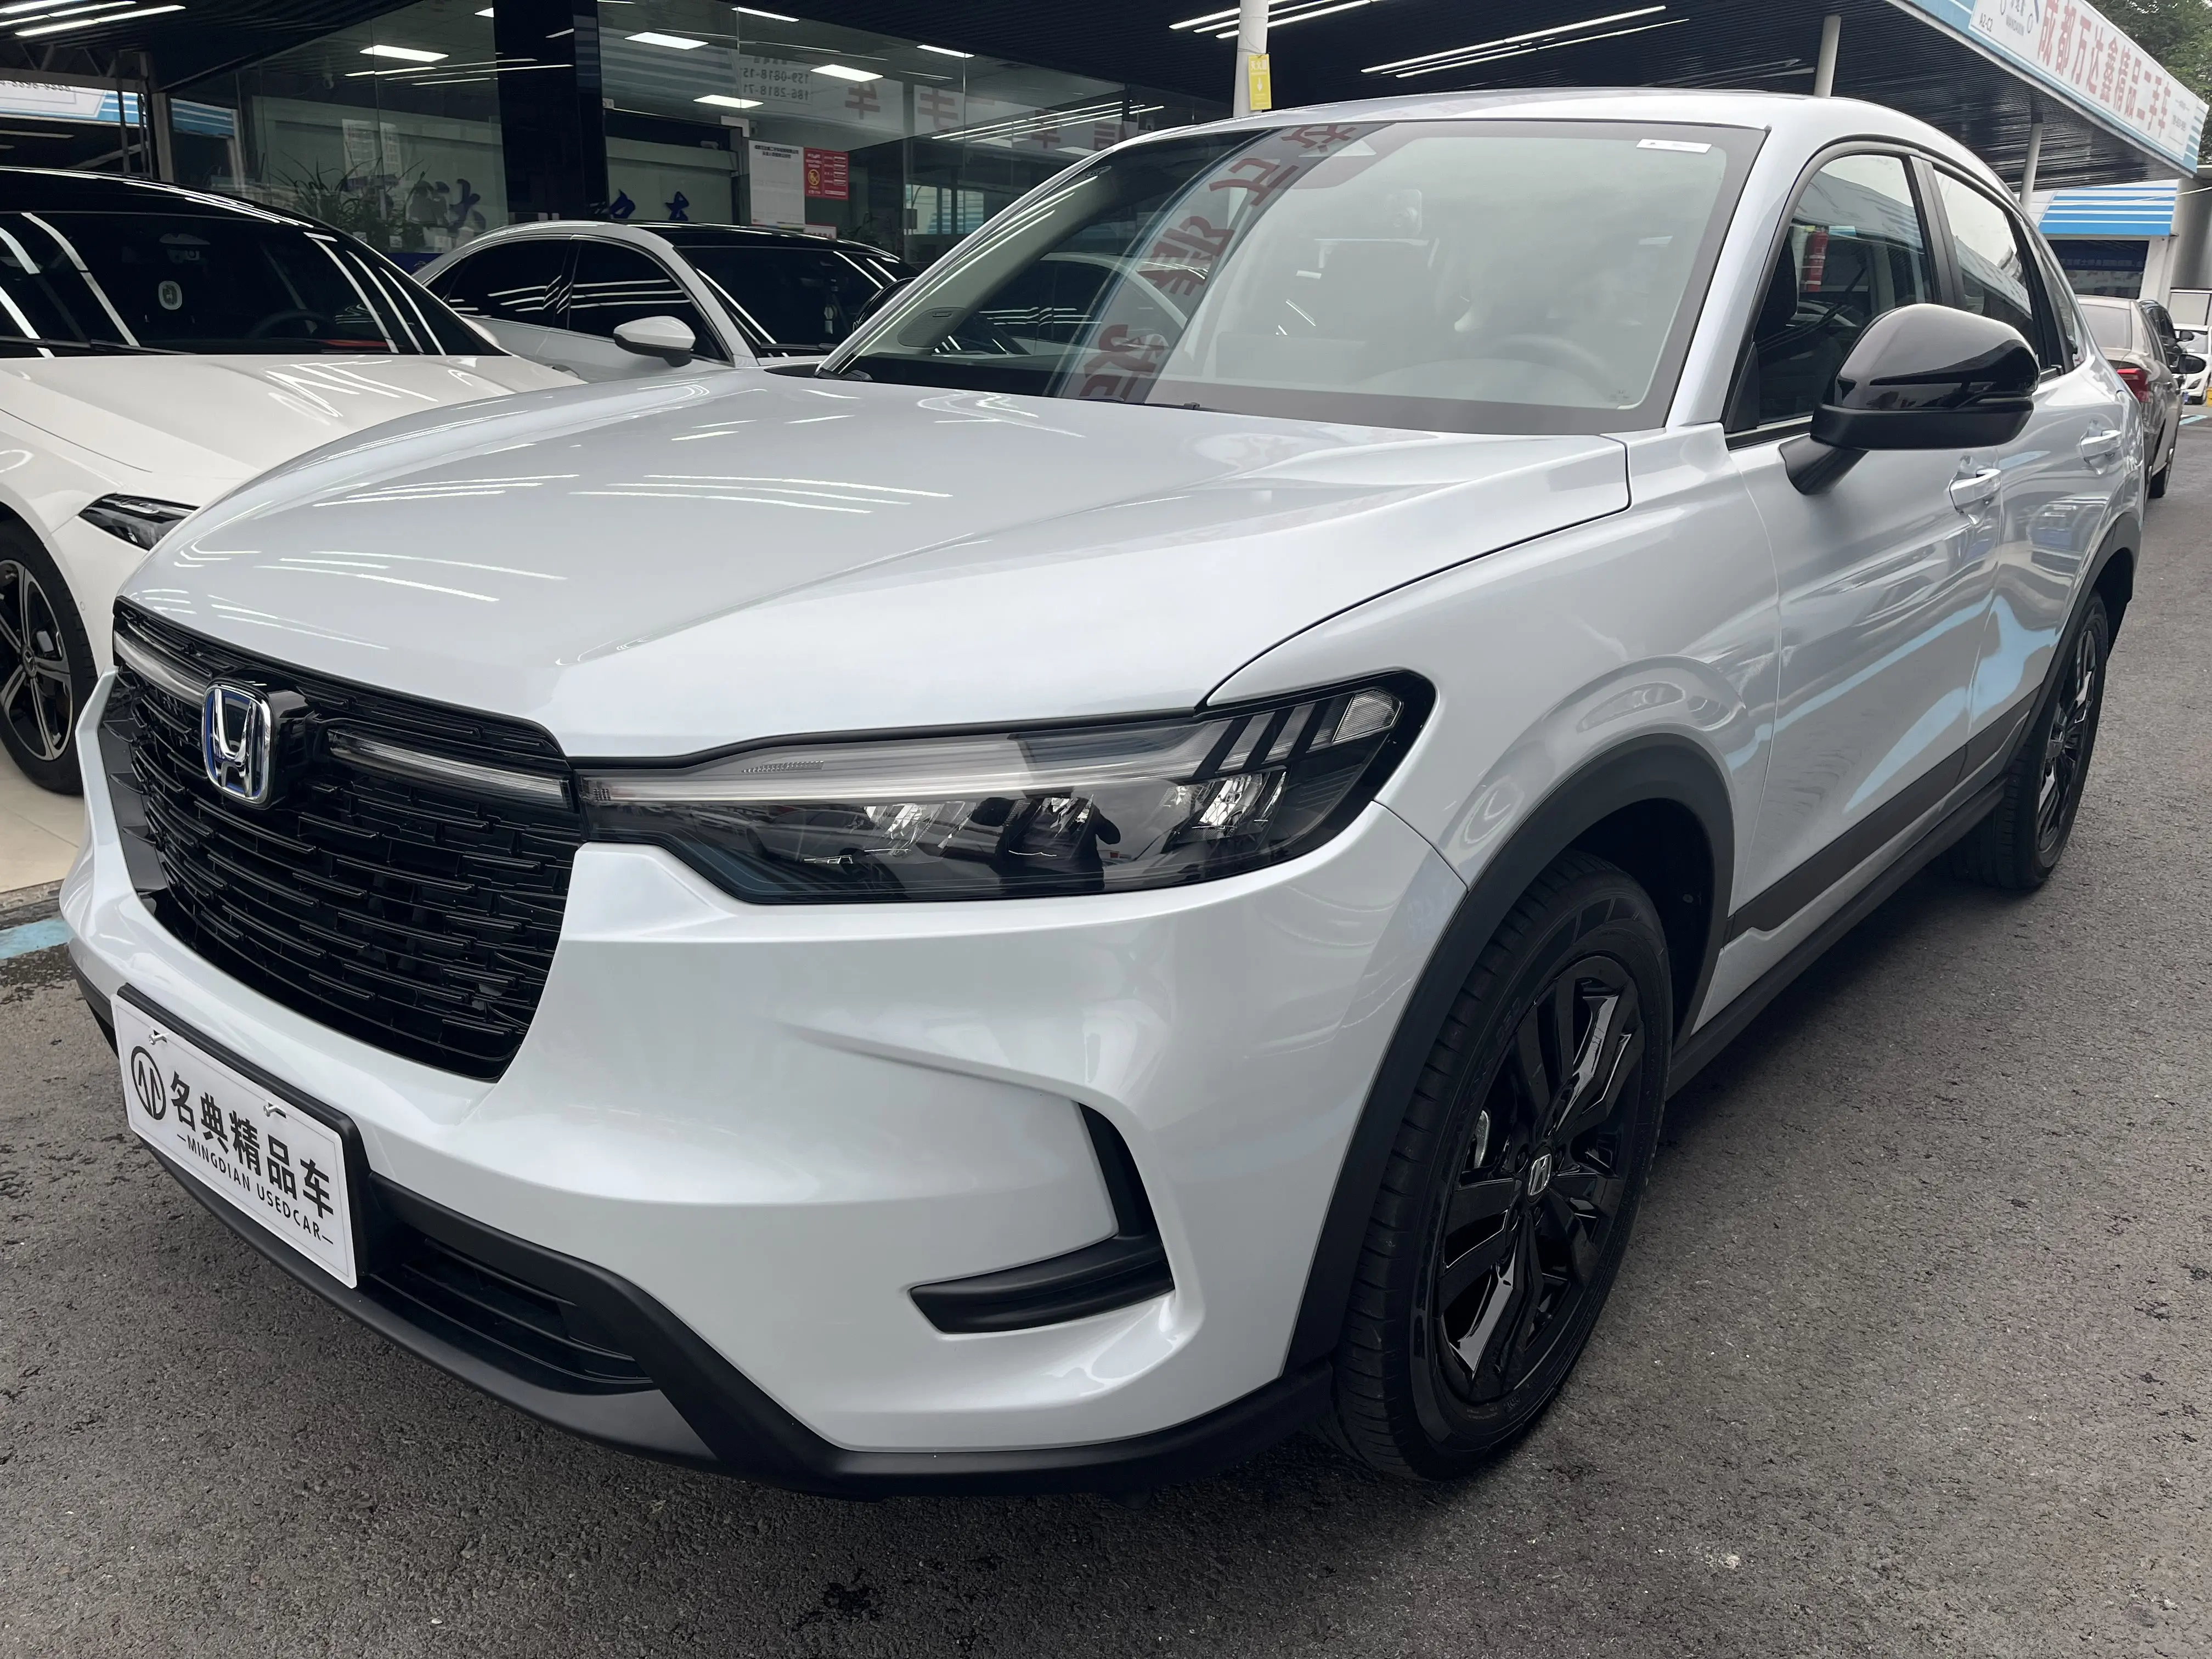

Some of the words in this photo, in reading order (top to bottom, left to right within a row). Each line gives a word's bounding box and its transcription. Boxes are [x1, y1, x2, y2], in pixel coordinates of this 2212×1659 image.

[170, 1070, 334, 1219] 名典精品车
